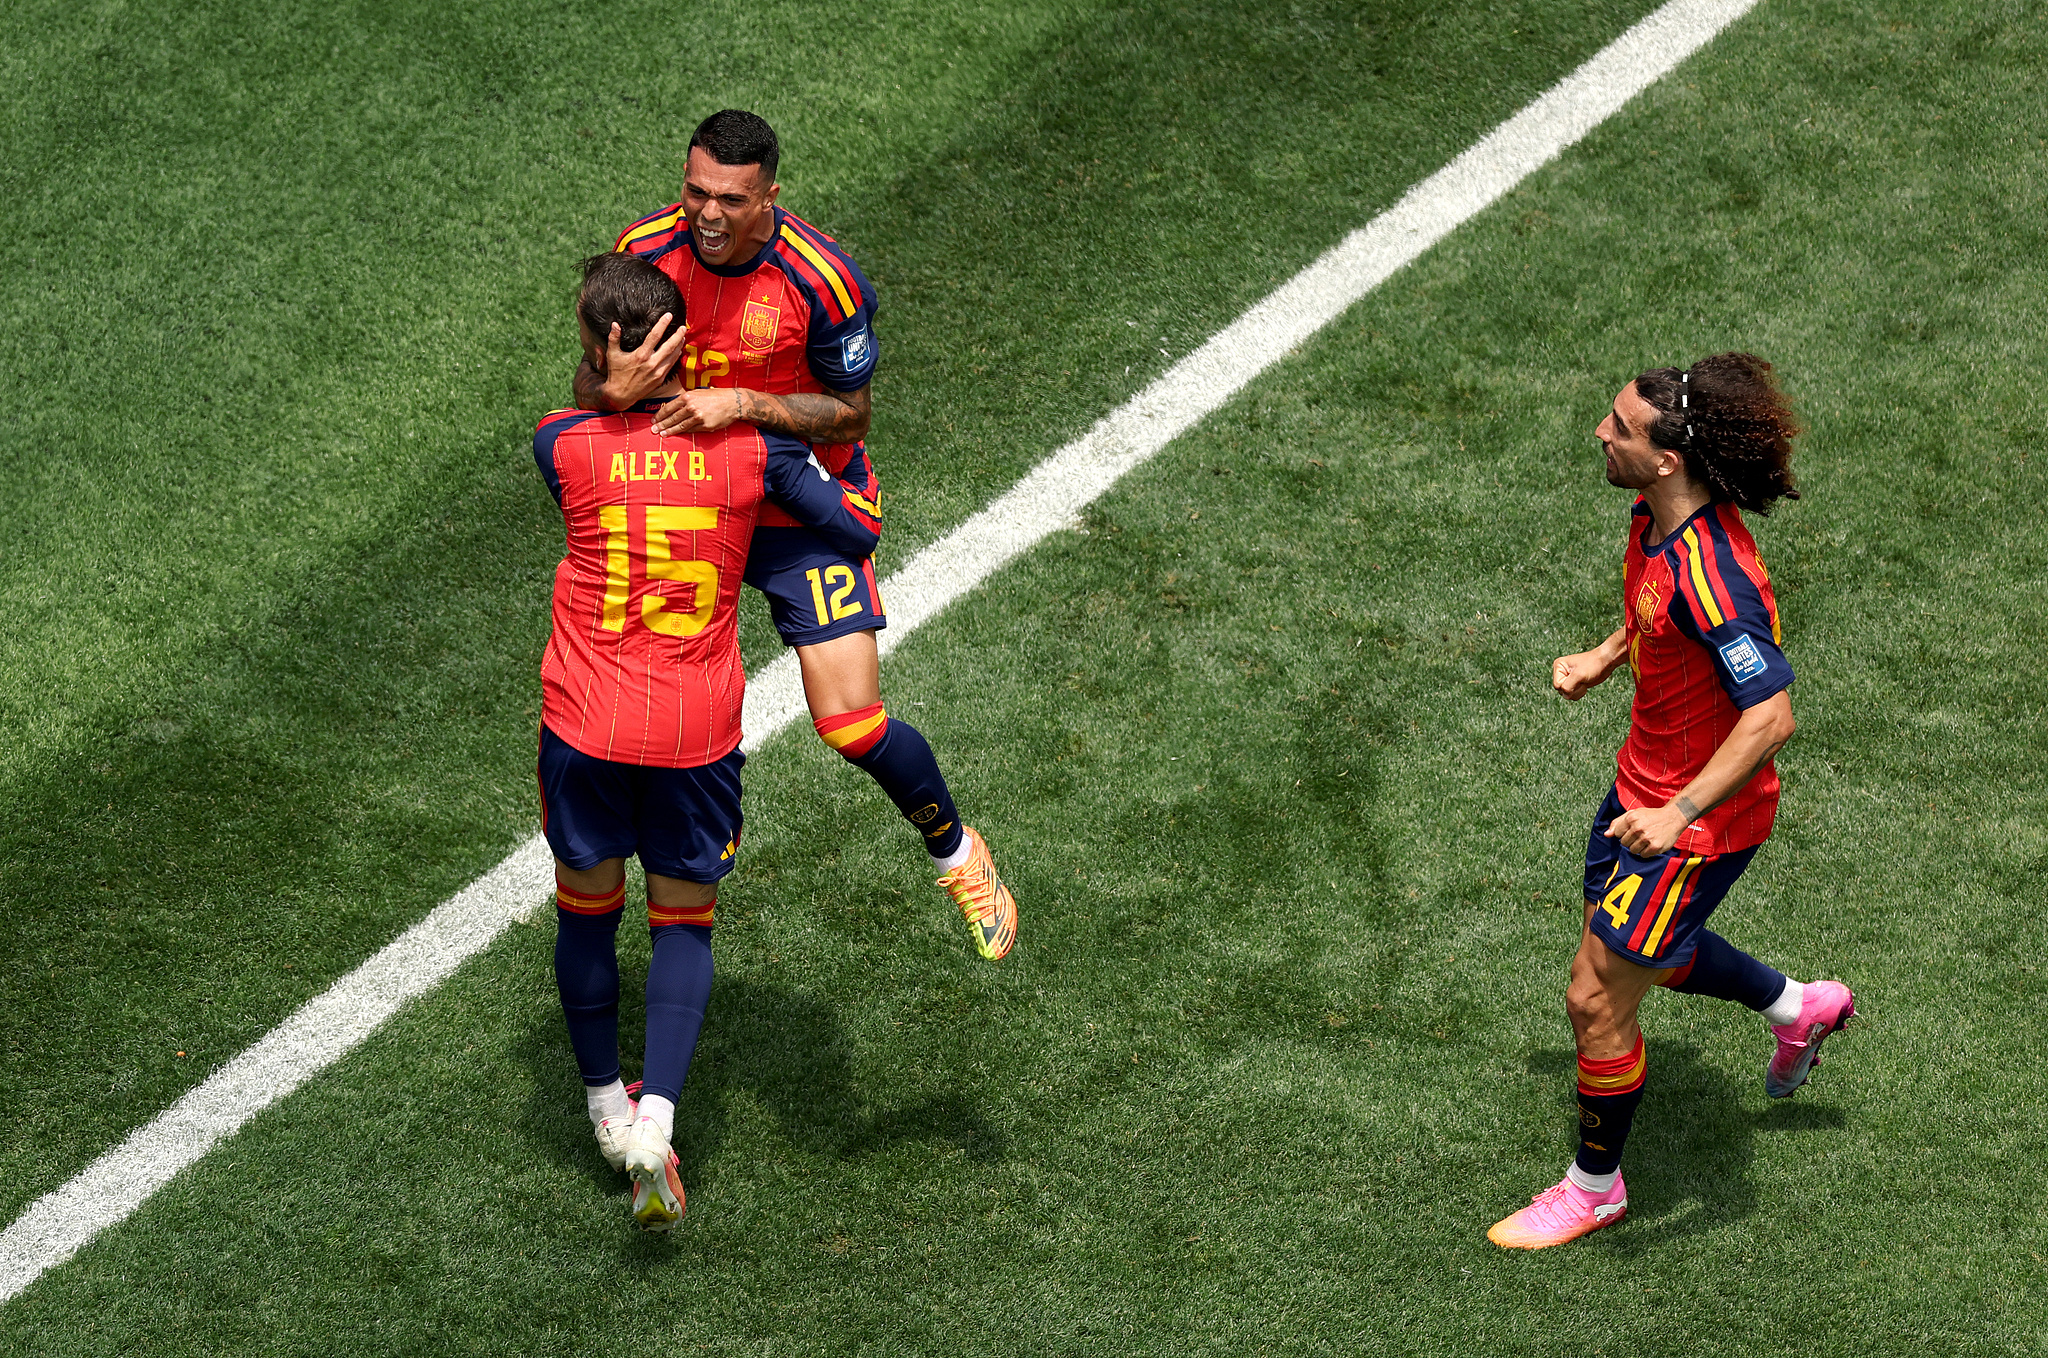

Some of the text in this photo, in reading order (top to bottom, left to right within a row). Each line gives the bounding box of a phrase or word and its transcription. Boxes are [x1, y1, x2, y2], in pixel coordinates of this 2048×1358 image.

[686, 344, 730, 389] 12
[609, 450, 713, 482] ALEX B.
[599, 505, 719, 637] 15
[805, 564, 864, 626] 12
[1729, 649, 1754, 665] UNITES
[1596, 860, 1644, 931] 4
